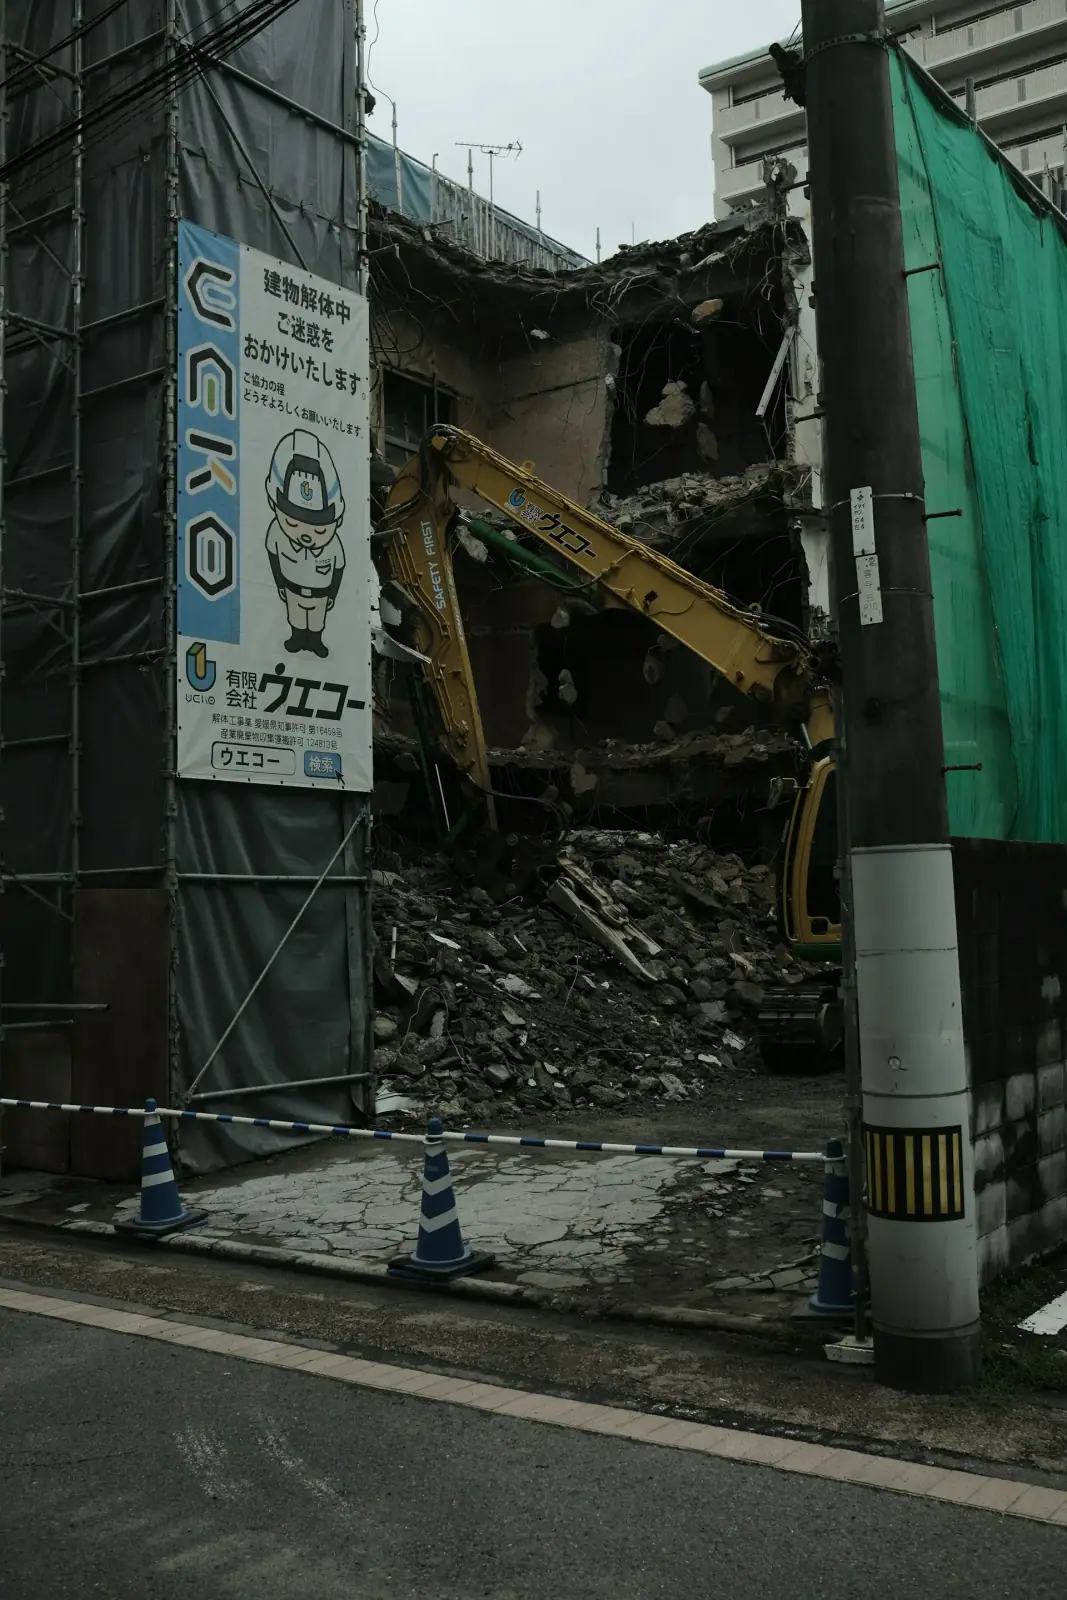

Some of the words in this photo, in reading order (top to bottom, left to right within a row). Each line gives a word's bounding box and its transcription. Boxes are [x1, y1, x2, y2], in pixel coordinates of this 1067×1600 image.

[263, 268, 351, 325] 建物解体中
[277, 311, 334, 353] ご迷惑を
[243, 333, 366, 400] おかけいたします。
[243, 371, 286, 397] ご協力の程
[243, 387, 363, 439] どうぞよろしくお願いいたします。
[422, 520, 436, 556] FIRST
[537, 513, 597, 558] ウエコー
[431, 561, 446, 610] SAFETY
[225, 669, 257, 690] 有限
[258, 662, 366, 721] ウエコー
[225, 690, 257, 710] 会社
[211, 713, 252, 728] 解体工事業
[220, 747, 280, 768] ウエコー
[309, 755, 335, 773] 検索
